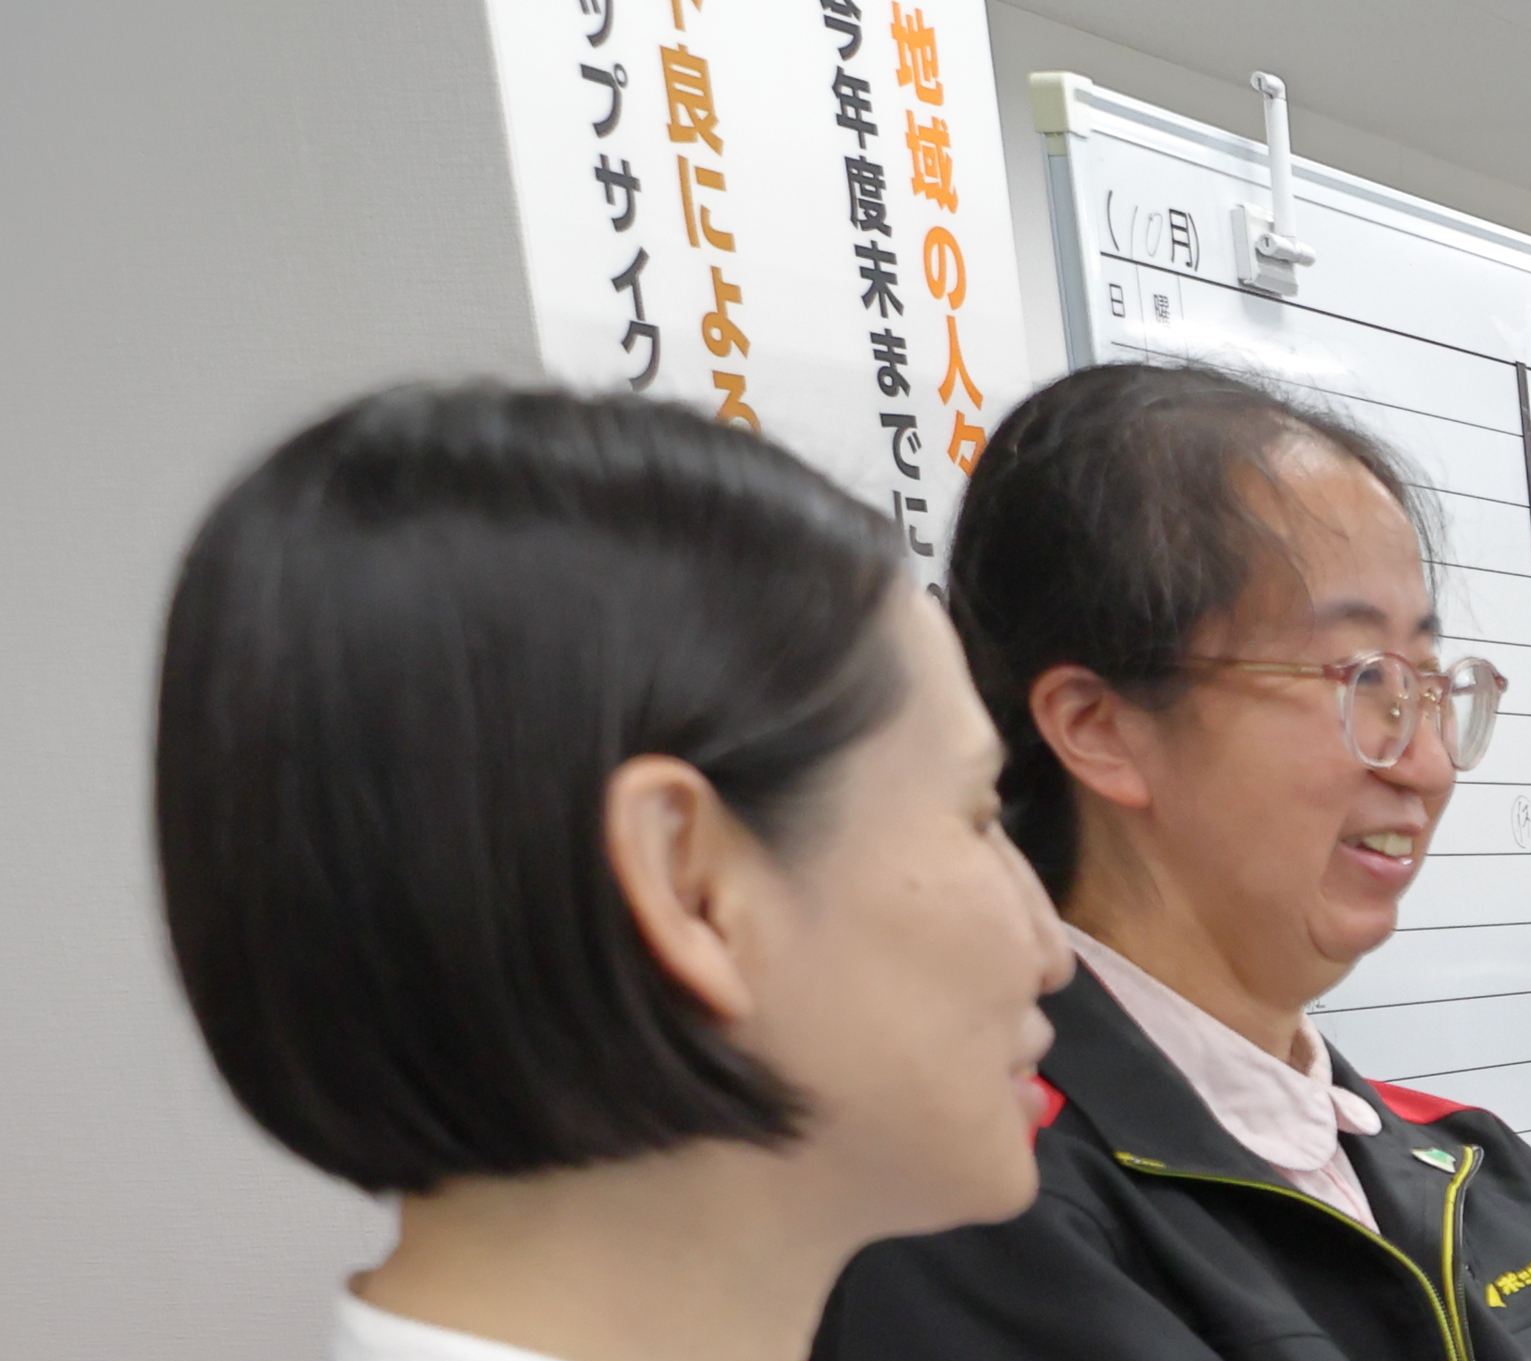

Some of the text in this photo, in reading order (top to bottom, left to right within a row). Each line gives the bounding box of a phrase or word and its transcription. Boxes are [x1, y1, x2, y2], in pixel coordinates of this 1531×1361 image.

[658, 0, 761, 437] 良による
[819, 0, 948, 607] 今年度末までに
